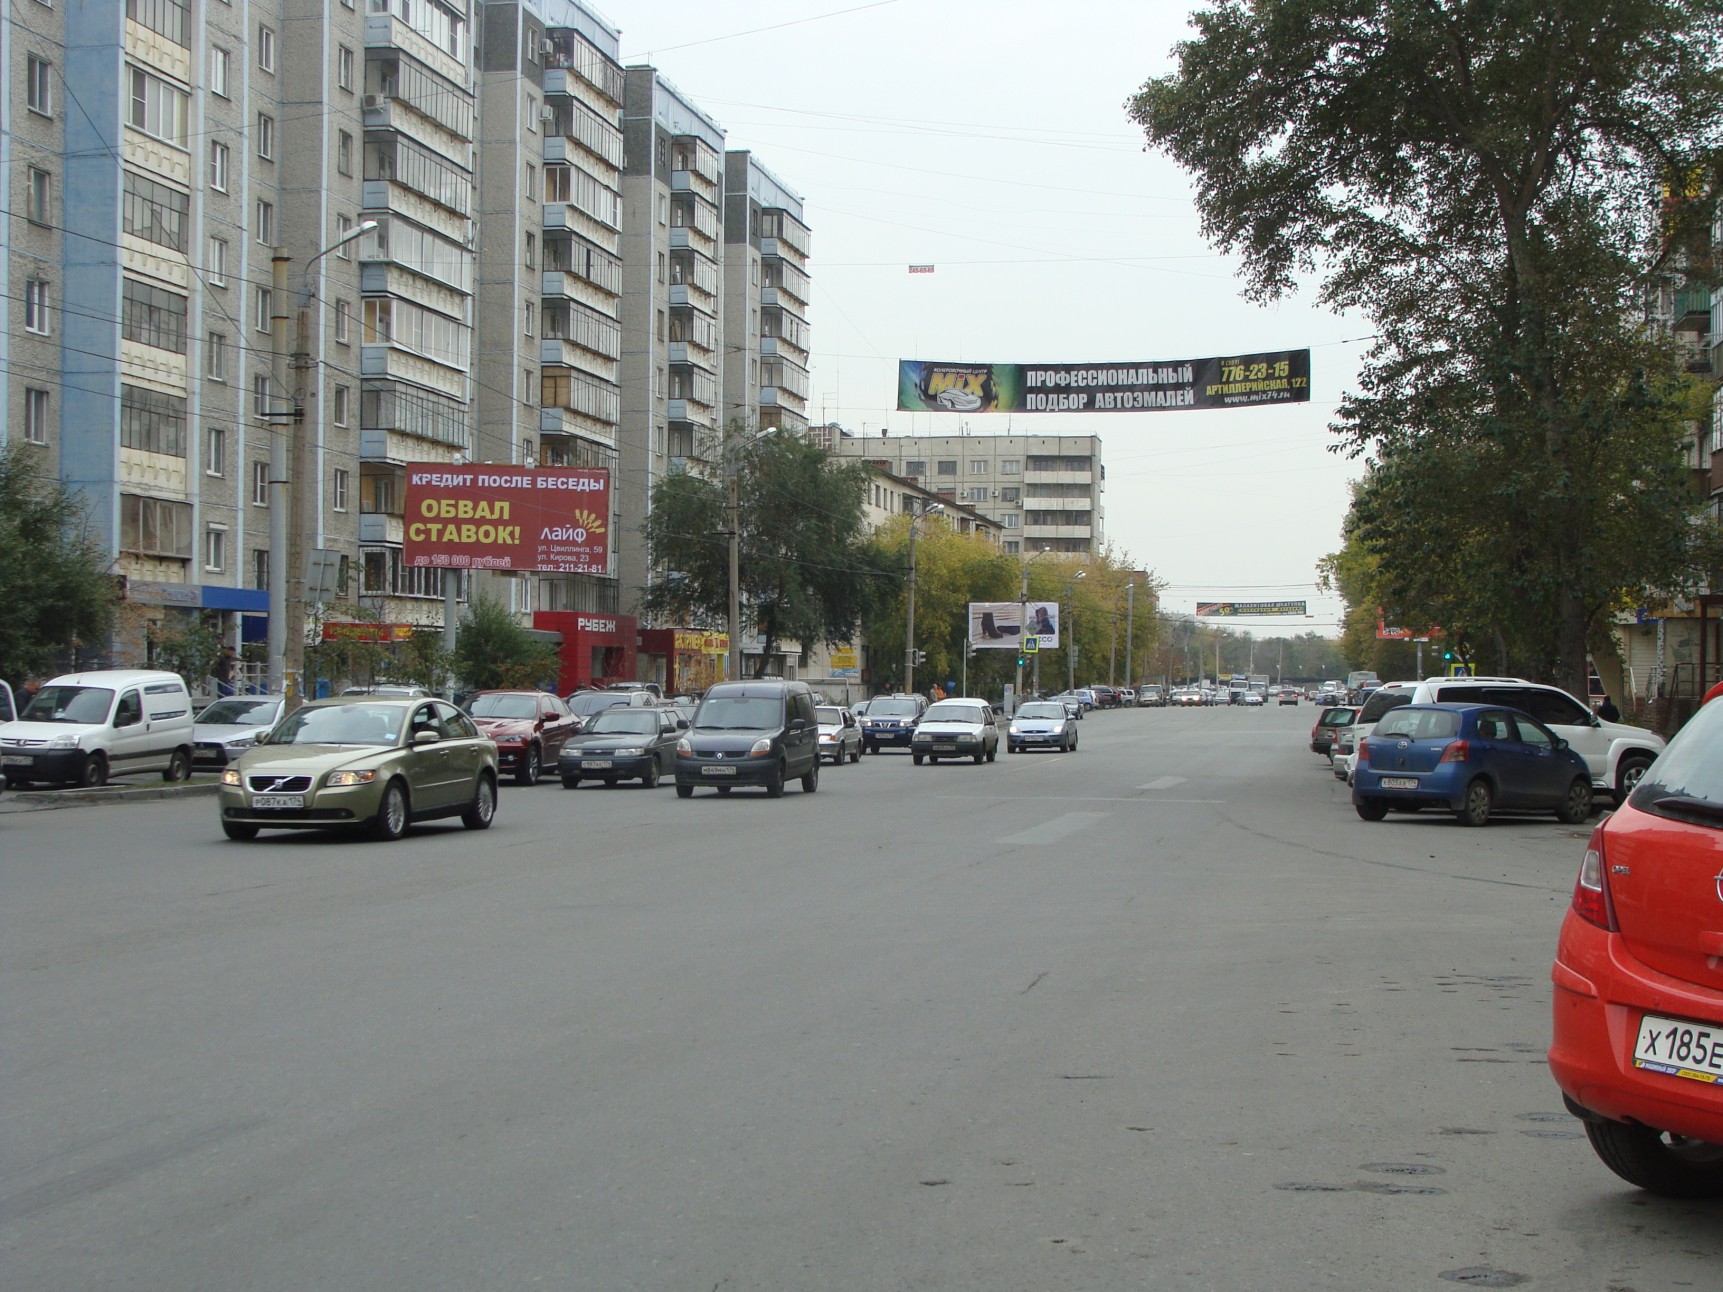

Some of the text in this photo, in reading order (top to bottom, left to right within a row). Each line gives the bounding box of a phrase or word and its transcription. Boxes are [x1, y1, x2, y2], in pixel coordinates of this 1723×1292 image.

[1026, 363, 1193, 387] ПРОФЕССИОНАЛЬНЫЙ
[1221, 361, 1289, 382] 776-23-15
[1206, 377, 1307, 396] АРТИЛЛЕРИЙСКАЯ, 122
[1026, 386, 1194, 412] ПОДБОР АВТОЭМАЛЕЙ
[1224, 391, 1291, 404] www.mix74.ru
[412, 473, 604, 492] КРЕДИТ ПОСЛЕ БЕСЕДЫ
[420, 499, 510, 520] ОБВАЛ
[409, 523, 520, 545] СТАВОК!
[550, 545, 591, 554] Цвиллинга,
[550, 554, 578, 562] Кирова,
[414, 554, 512, 568] до 150 000 рублей
[559, 563, 602, 573] 211-21-81
[577, 618, 616, 632] РУБЕЖ
